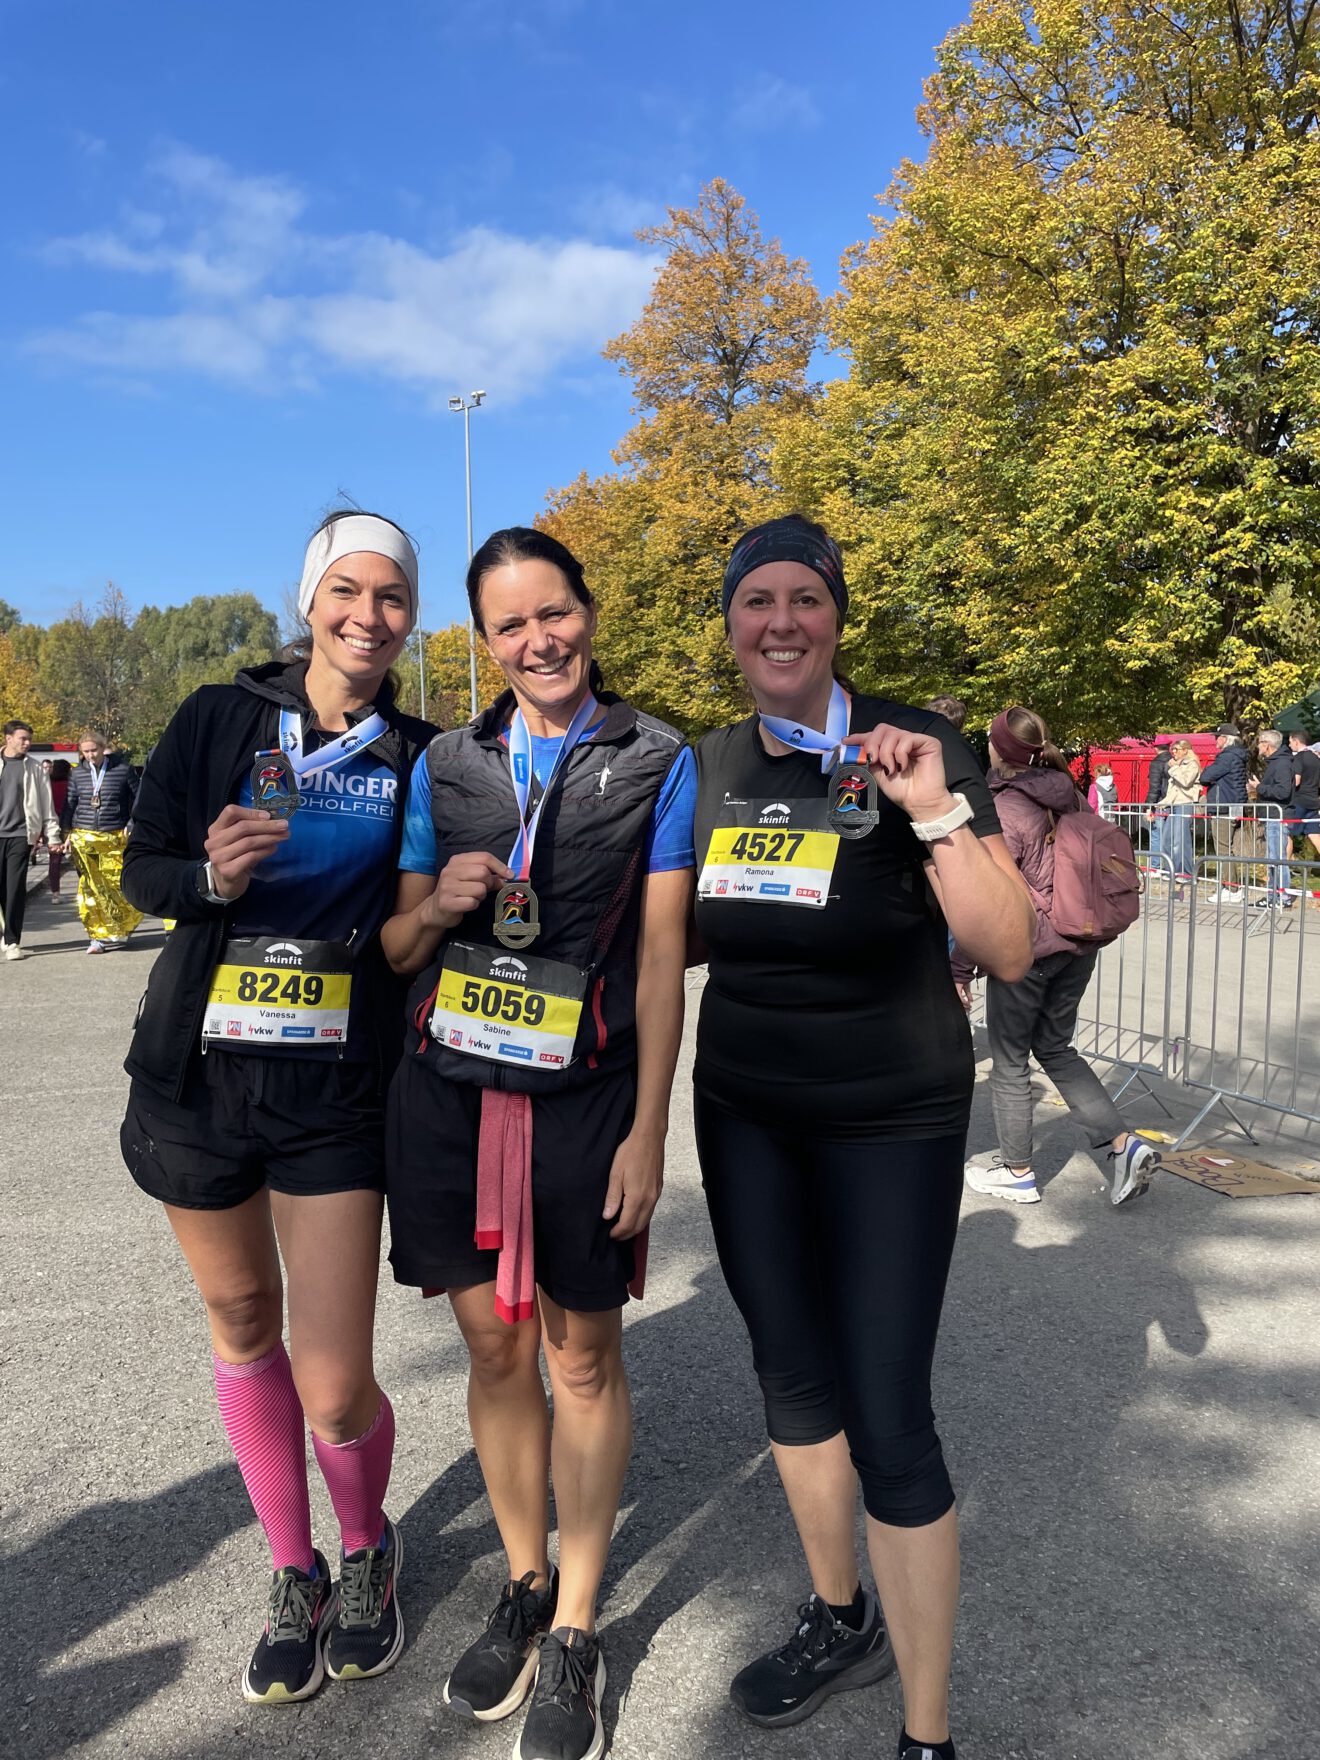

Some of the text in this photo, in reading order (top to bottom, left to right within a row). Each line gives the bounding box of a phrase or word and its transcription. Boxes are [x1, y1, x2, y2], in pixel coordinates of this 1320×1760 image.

[758, 816, 790, 824] skinfit
[730, 832, 805, 862] 4527
[745, 867, 774, 876] Ramona
[737, 883, 754, 892] vkw
[264, 954, 303, 966] skinfit
[488, 967, 527, 982] skinfit
[237, 971, 324, 1006] 8249
[461, 980, 546, 1026] 5059
[259, 1009, 296, 1019] Vanessa
[254, 1025, 274, 1035] vkw
[483, 1024, 512, 1036] Sabine
[473, 1039, 491, 1050] vkw
[540, 1054, 556, 1062] ORF
